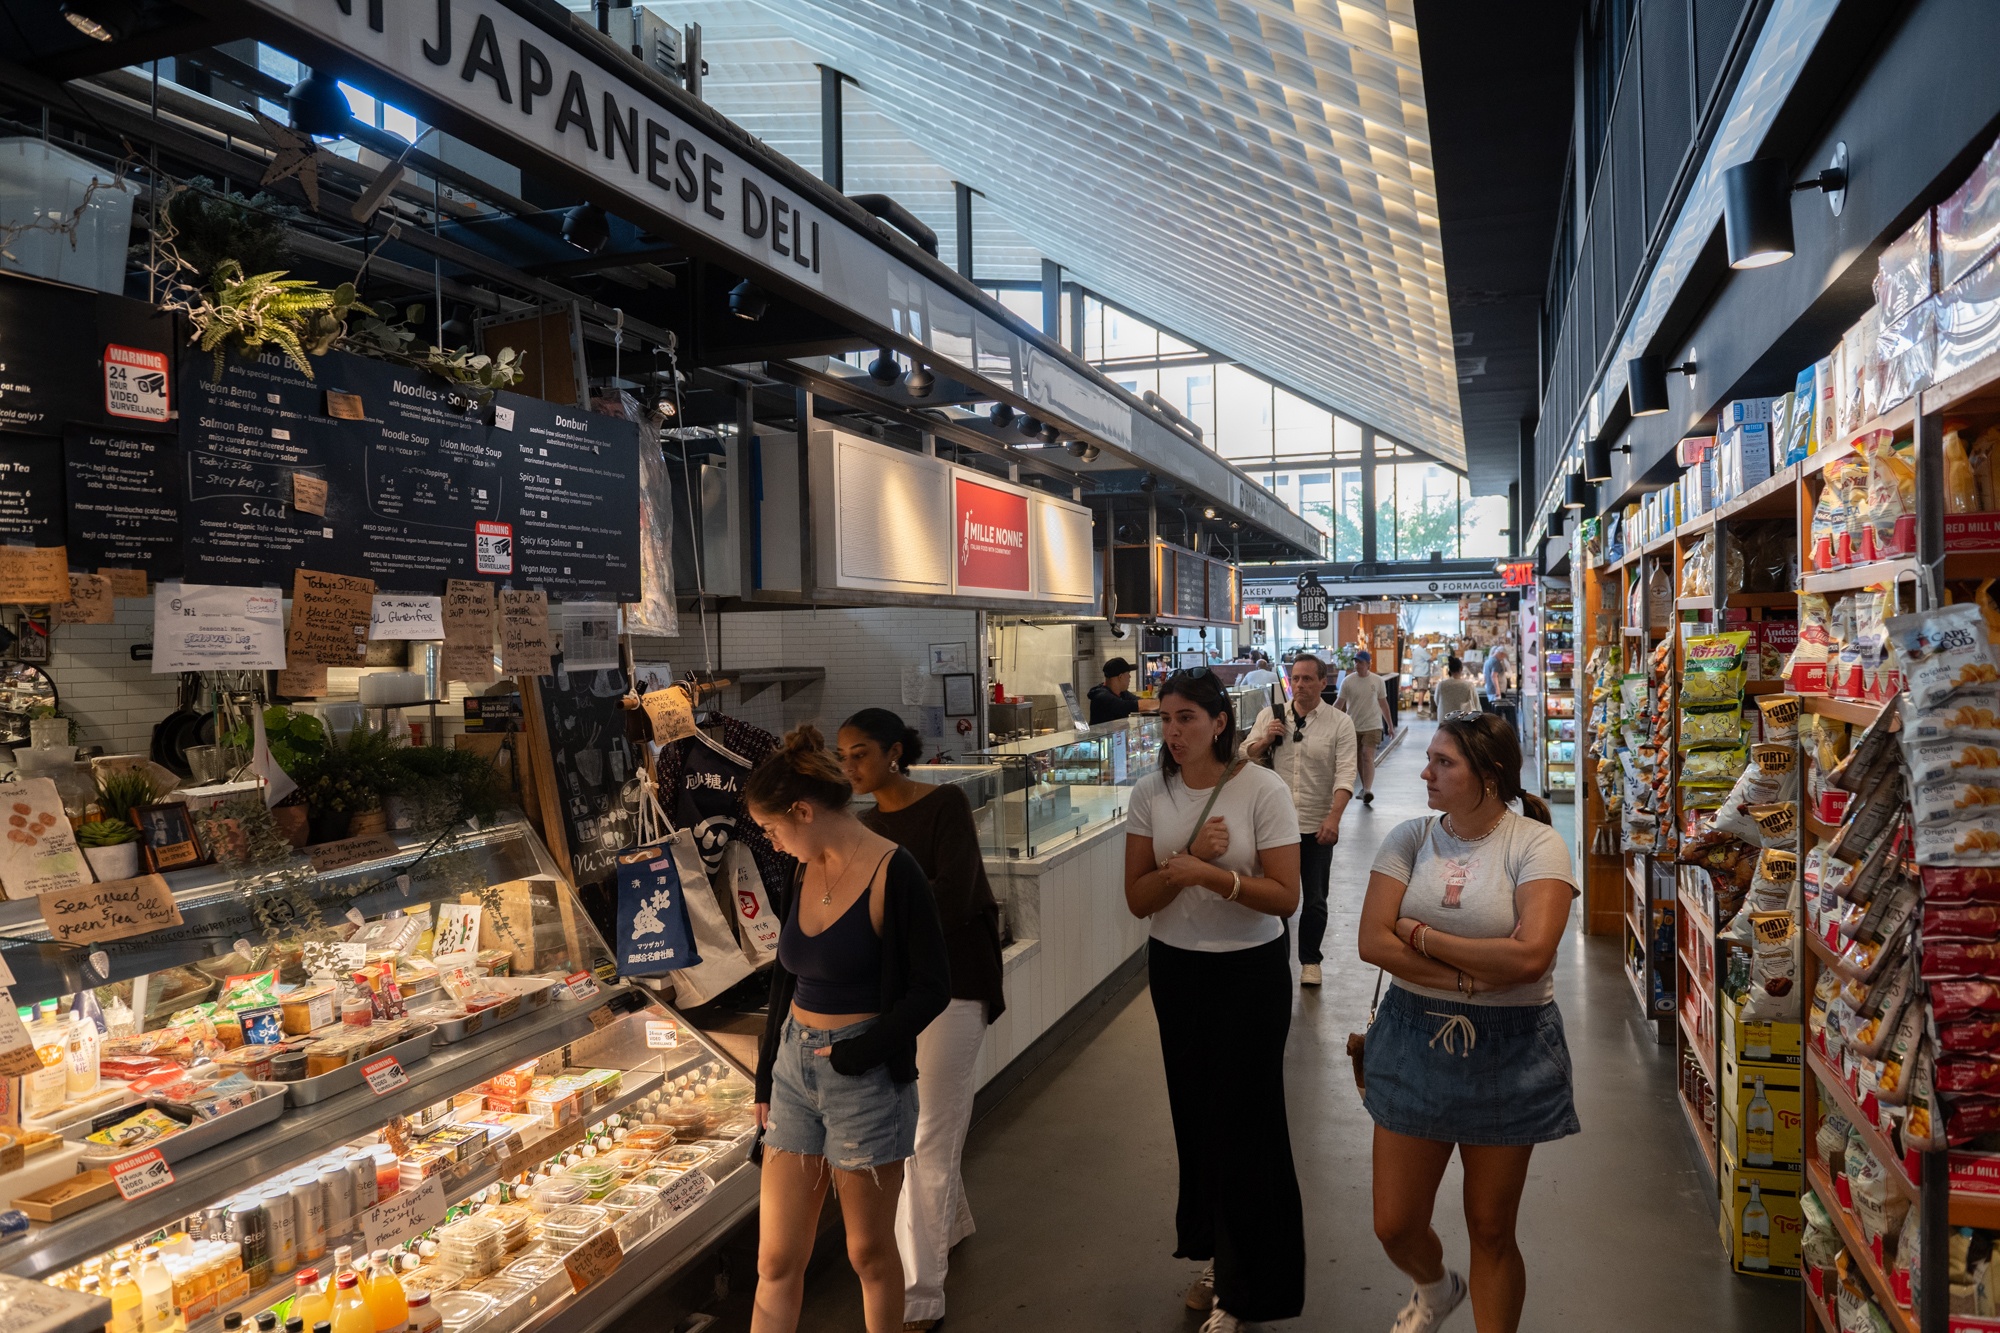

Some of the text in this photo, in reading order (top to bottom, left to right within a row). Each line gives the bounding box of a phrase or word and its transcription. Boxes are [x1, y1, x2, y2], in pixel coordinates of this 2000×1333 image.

[423, 0, 820, 274] JAPANESE DELI
[109, 348, 163, 368] WARNING
[109, 365, 127, 382] 24
[229, 366, 244, 376] daily
[247, 370, 269, 380] special
[305, 380, 317, 390] box
[15, 385, 31, 393] milk
[109, 380, 128, 391] HOUR
[200, 380, 257, 400] Vegan Bento
[110, 391, 138, 404] VIDEO
[393, 380, 478, 411] Noodles Soups
[110, 402, 165, 417] SURVEILLANCE
[225, 399, 241, 409] sides
[262, 407, 275, 416] day
[200, 416, 264, 436] Salmon Bento
[555, 415, 588, 432] Donburi
[90, 437, 155, 452] Low Caffein Tea
[209, 433, 308, 455] miso cured and sheered salmon
[382, 428, 430, 447] Noodle Soup
[106, 449, 132, 458] Iced add
[225, 445, 298, 463] sides day salad
[440, 439, 502, 462] Udon Noodle Soup
[519, 445, 533, 455] Tuna
[13, 464, 30, 475] Tea
[93, 463, 120, 475] hoji cha
[425, 470, 450, 480] Toppings
[117, 473, 129, 482] cha
[519, 472, 550, 485] Spicy Tuna
[76, 503, 93, 512] Home
[95, 505, 112, 513] made
[241, 502, 288, 520] Salad
[200, 520, 322, 537] Seaweed Organic Root Greens
[363, 524, 391, 535] MISO SOUP
[478, 522, 509, 535] WARNING
[1945, 521, 1992, 534] RED MILL
[478, 537, 489, 548] 24
[520, 535, 572, 549] Spicy King Salmon
[970, 522, 1023, 549] MILLE NONNE
[105, 551, 136, 561] tap water
[200, 554, 242, 564] Yuzu Coleslaw
[363, 551, 430, 565] MEDICINAL TURMERIC SOUP
[478, 555, 495, 564] VIDEO
[479, 563, 510, 571] SURVEILLANCE
[521, 565, 557, 575] Vegan Macro
[1505, 563, 1534, 586] EXIT
[303, 575, 373, 595] Today's SPECIAL
[1243, 587, 1273, 596] AKERY
[1304, 586, 1323, 596] TOP
[183, 607, 197, 617] Ni
[1301, 597, 1326, 613] HOPS
[334, 609, 348, 620] Cod
[1302, 612, 1326, 622] BEER
[184, 632, 232, 644] SHAVED
[308, 632, 350, 645] Mackerel
[1931, 629, 1970, 643] CAPE
[1939, 637, 1975, 651] COD
[1919, 666, 1951, 680] Original
[1776, 712, 1798, 724] CHIPS
[1757, 752, 1791, 763] TURTLE
[1919, 746, 1954, 755] Original
[1764, 763, 1786, 771] CHIPS
[1923, 784, 1956, 795] Original
[1760, 809, 1795, 828] TURTLE
[1770, 819, 1793, 833] CHIPS
[1923, 828, 1957, 837] Original
[573, 852, 597, 876] Ni
[1766, 861, 1797, 872] TURTLE
[1771, 870, 1793, 881] CHIPS
[136, 897, 161, 912] all
[58, 904, 174, 940] green day!
[192, 914, 249, 938] Gluten Free
[1758, 916, 1790, 932] TURTLE
[151, 930, 185, 945] Macro
[1767, 926, 1789, 939] CHIPS
[364, 1059, 394, 1075] WARNING
[373, 1078, 388, 1089] VIDEO
[376, 1079, 403, 1094] SURVEILLANCE
[114, 1154, 157, 1174] WARNING
[1954, 1163, 2000, 1179] RED MILL
[122, 1178, 144, 1191] VIDEO
[126, 1178, 166, 1198] SURVEILLANCE
[372, 1184, 435, 1222] If you don't see
